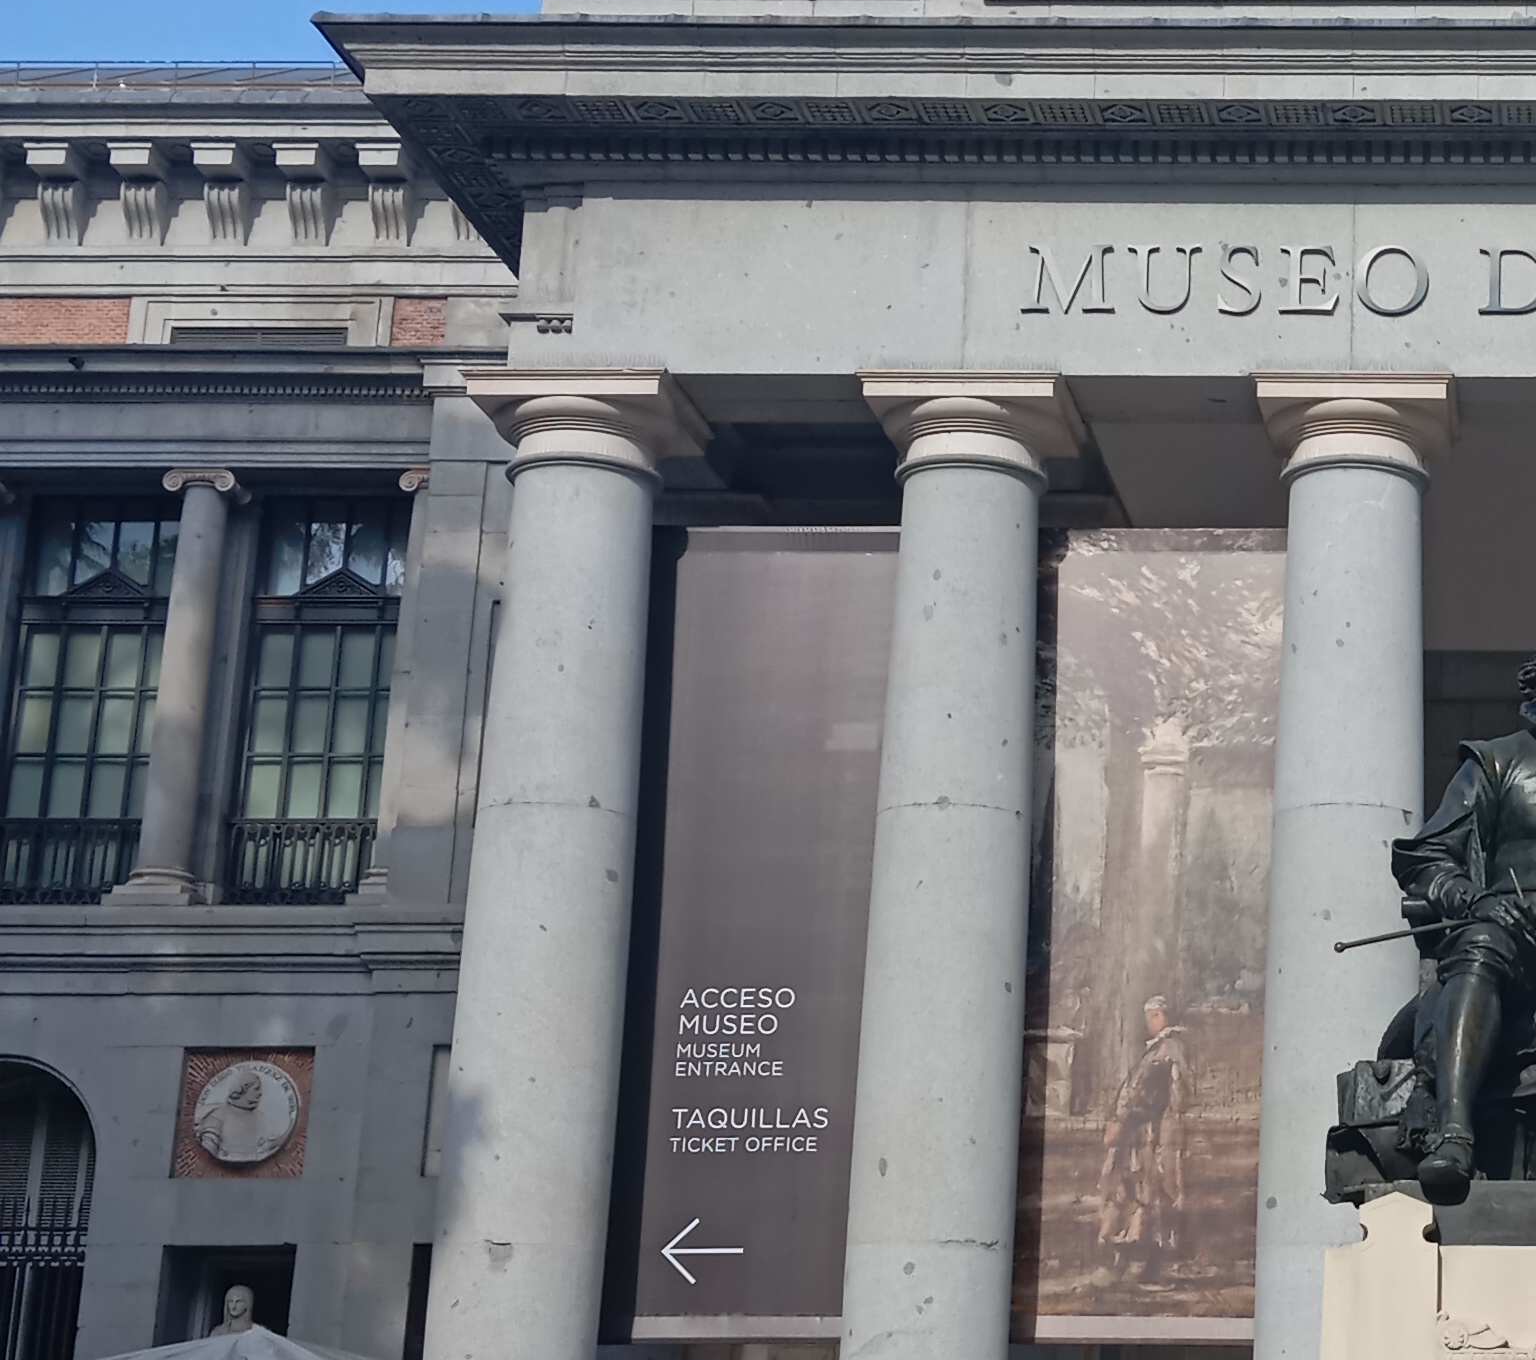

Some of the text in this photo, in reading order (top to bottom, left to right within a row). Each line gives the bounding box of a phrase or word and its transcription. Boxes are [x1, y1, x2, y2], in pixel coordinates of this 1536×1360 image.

[1019, 243, 1430, 317] MUSEO
[680, 987, 796, 1009] ACCESO
[678, 1013, 779, 1035] MUSEO
[676, 1042, 761, 1058] MUSEUM
[675, 1061, 784, 1077] ENTRANCE
[671, 1107, 829, 1129] TAQUILLAS
[669, 1136, 818, 1153] TICKET OFFICE
